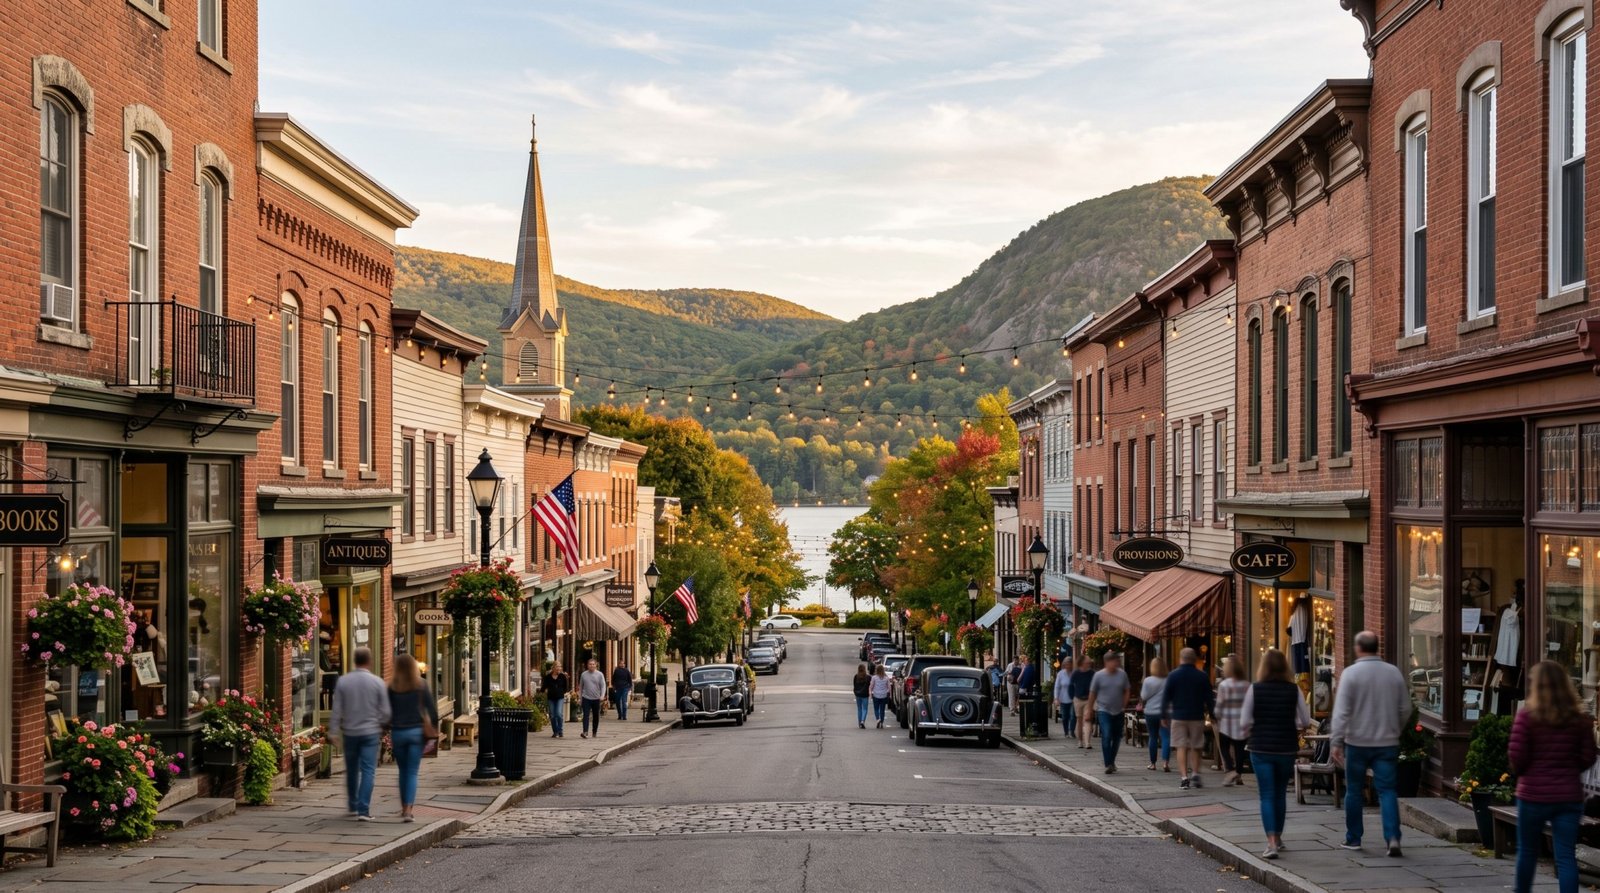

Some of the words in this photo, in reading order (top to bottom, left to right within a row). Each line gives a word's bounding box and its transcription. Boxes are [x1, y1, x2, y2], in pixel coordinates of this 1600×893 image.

[328, 545, 387, 560] ANTIQUES
[1118, 550, 1179, 560] PROVISIONS
[1237, 553, 1289, 568] CAFE
